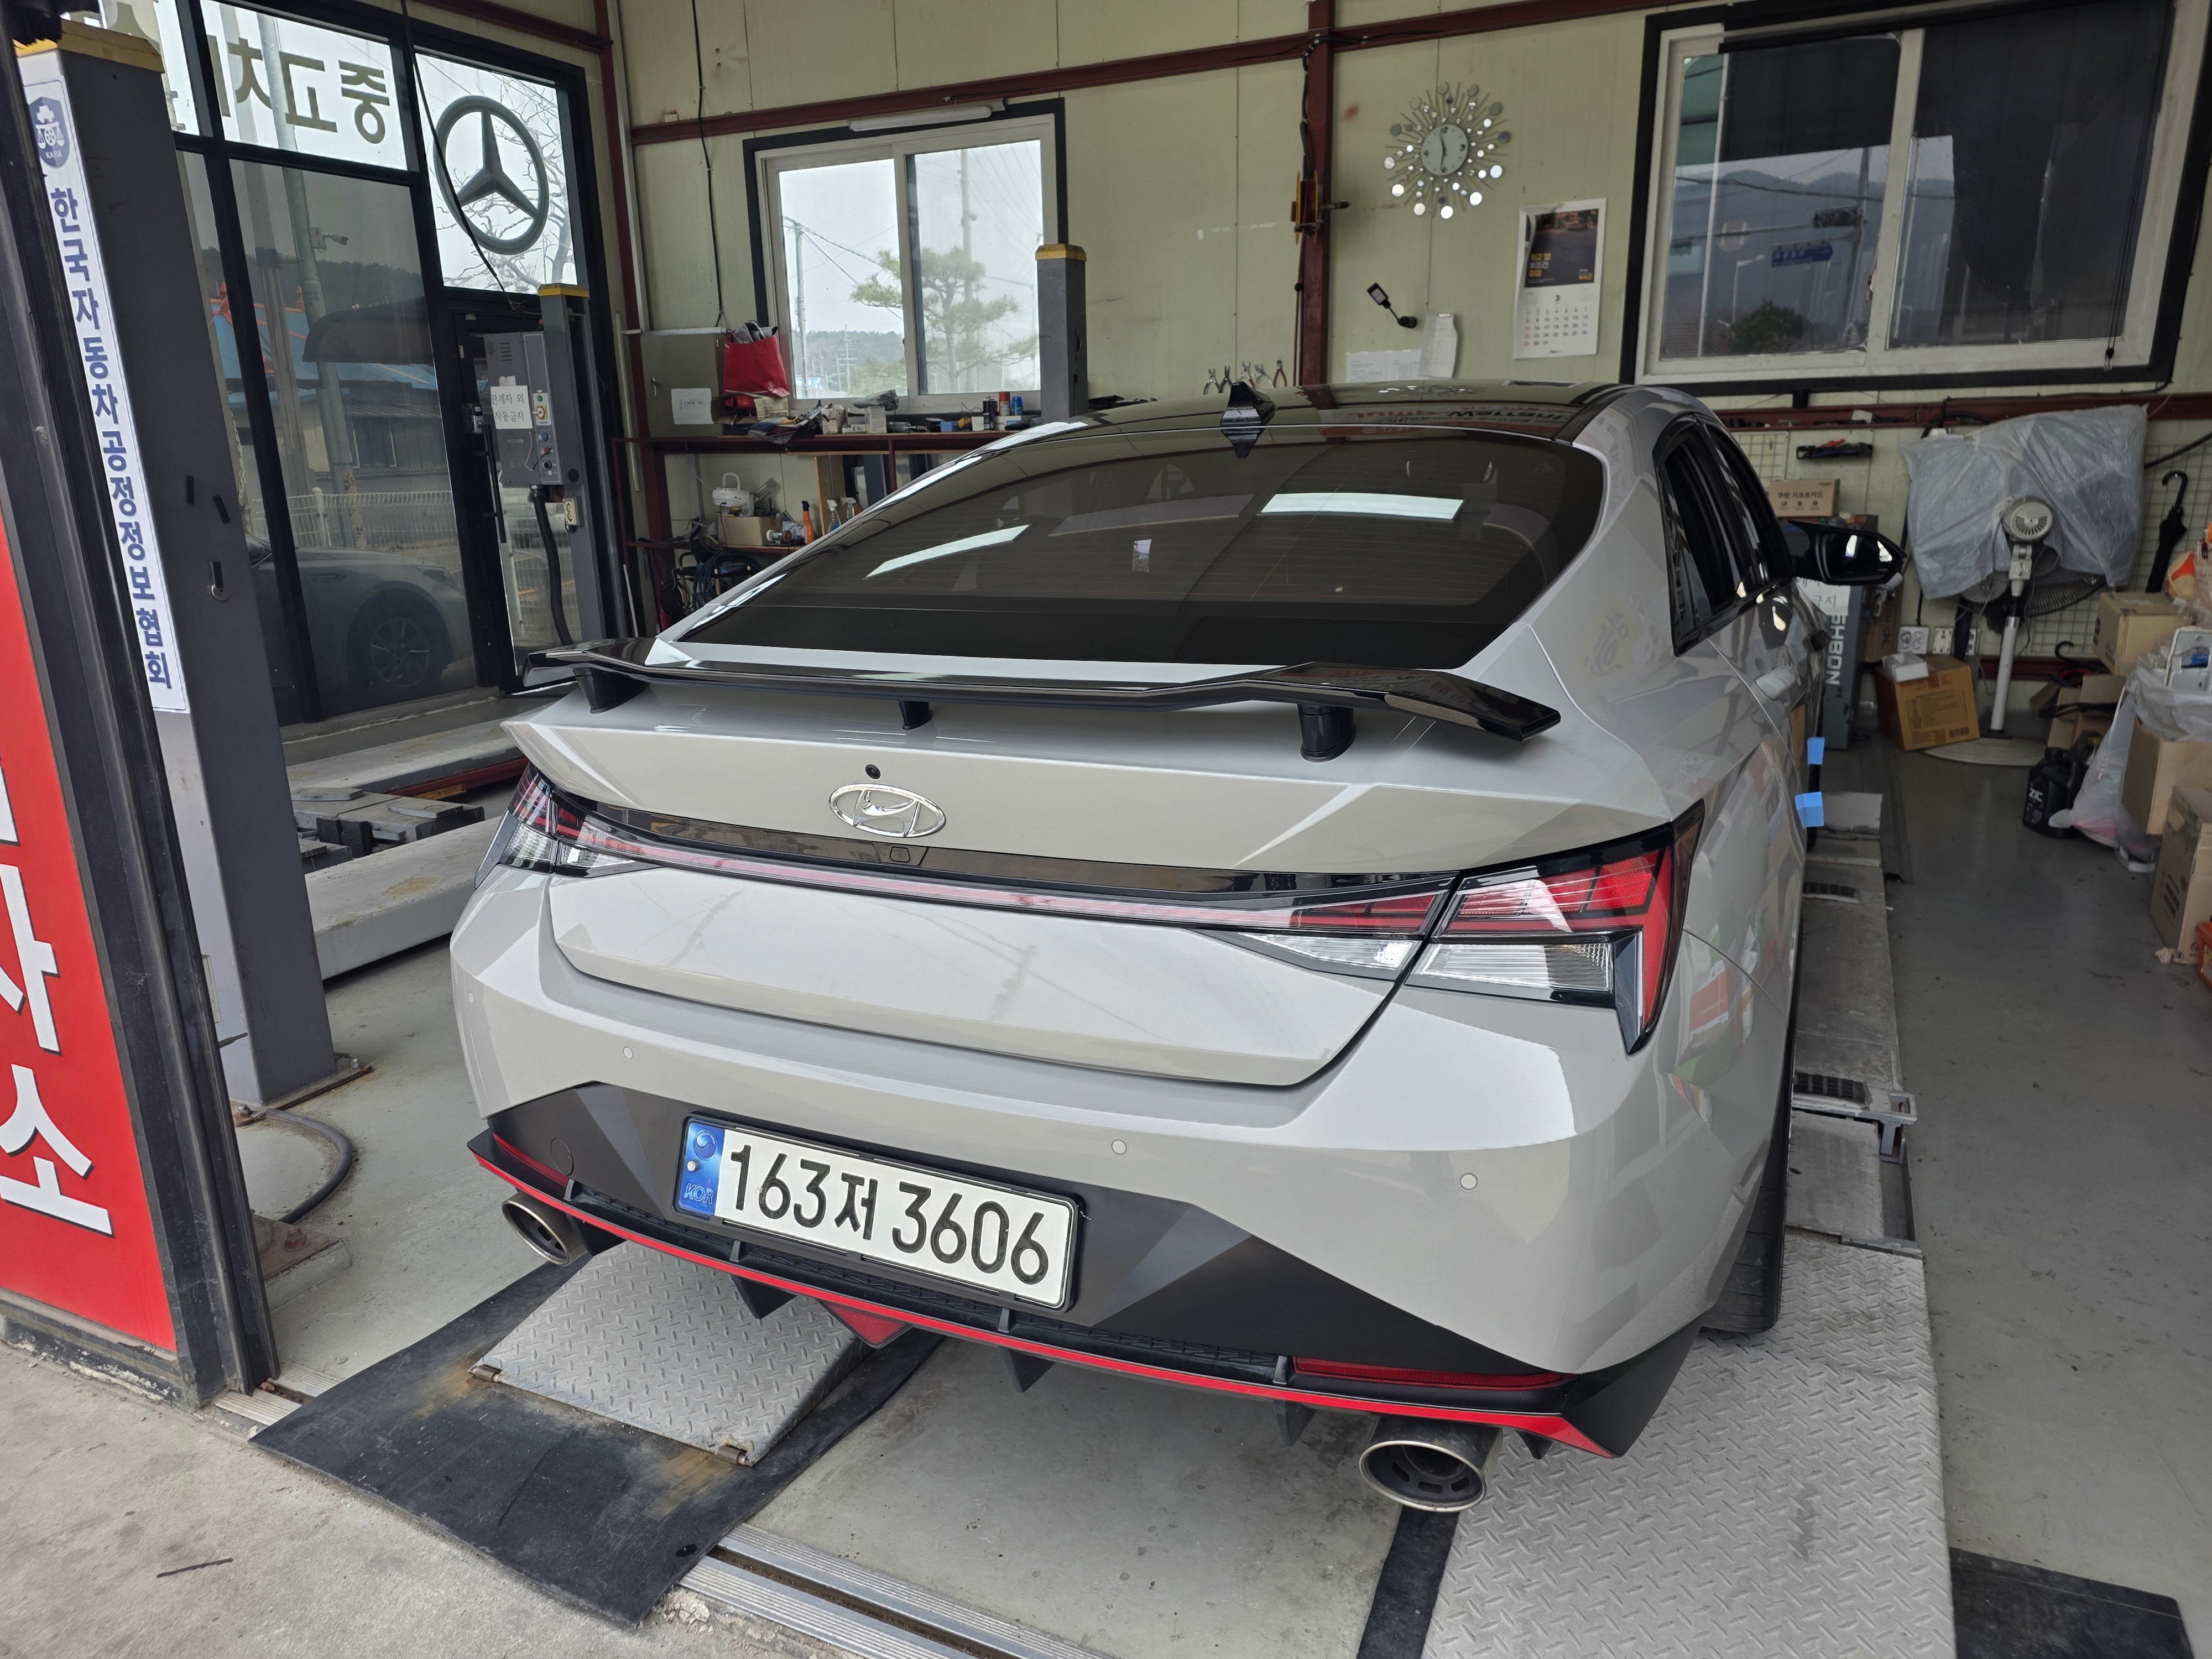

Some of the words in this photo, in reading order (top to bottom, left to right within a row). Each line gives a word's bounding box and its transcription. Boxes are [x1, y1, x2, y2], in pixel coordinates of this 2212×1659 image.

[45, 150, 63, 159] KAFIA
[491, 393, 512, 405] 관계자
[517, 393, 524, 404] 외
[495, 411, 524, 422] 작동금지
[50, 187, 173, 689] 한국자동차공정정보협회
[2029, 787, 2043, 802] ZIC
[684, 1183, 714, 1204] KOR
[731, 1145, 878, 1240] 163저
[892, 1181, 1048, 1285] 3606
